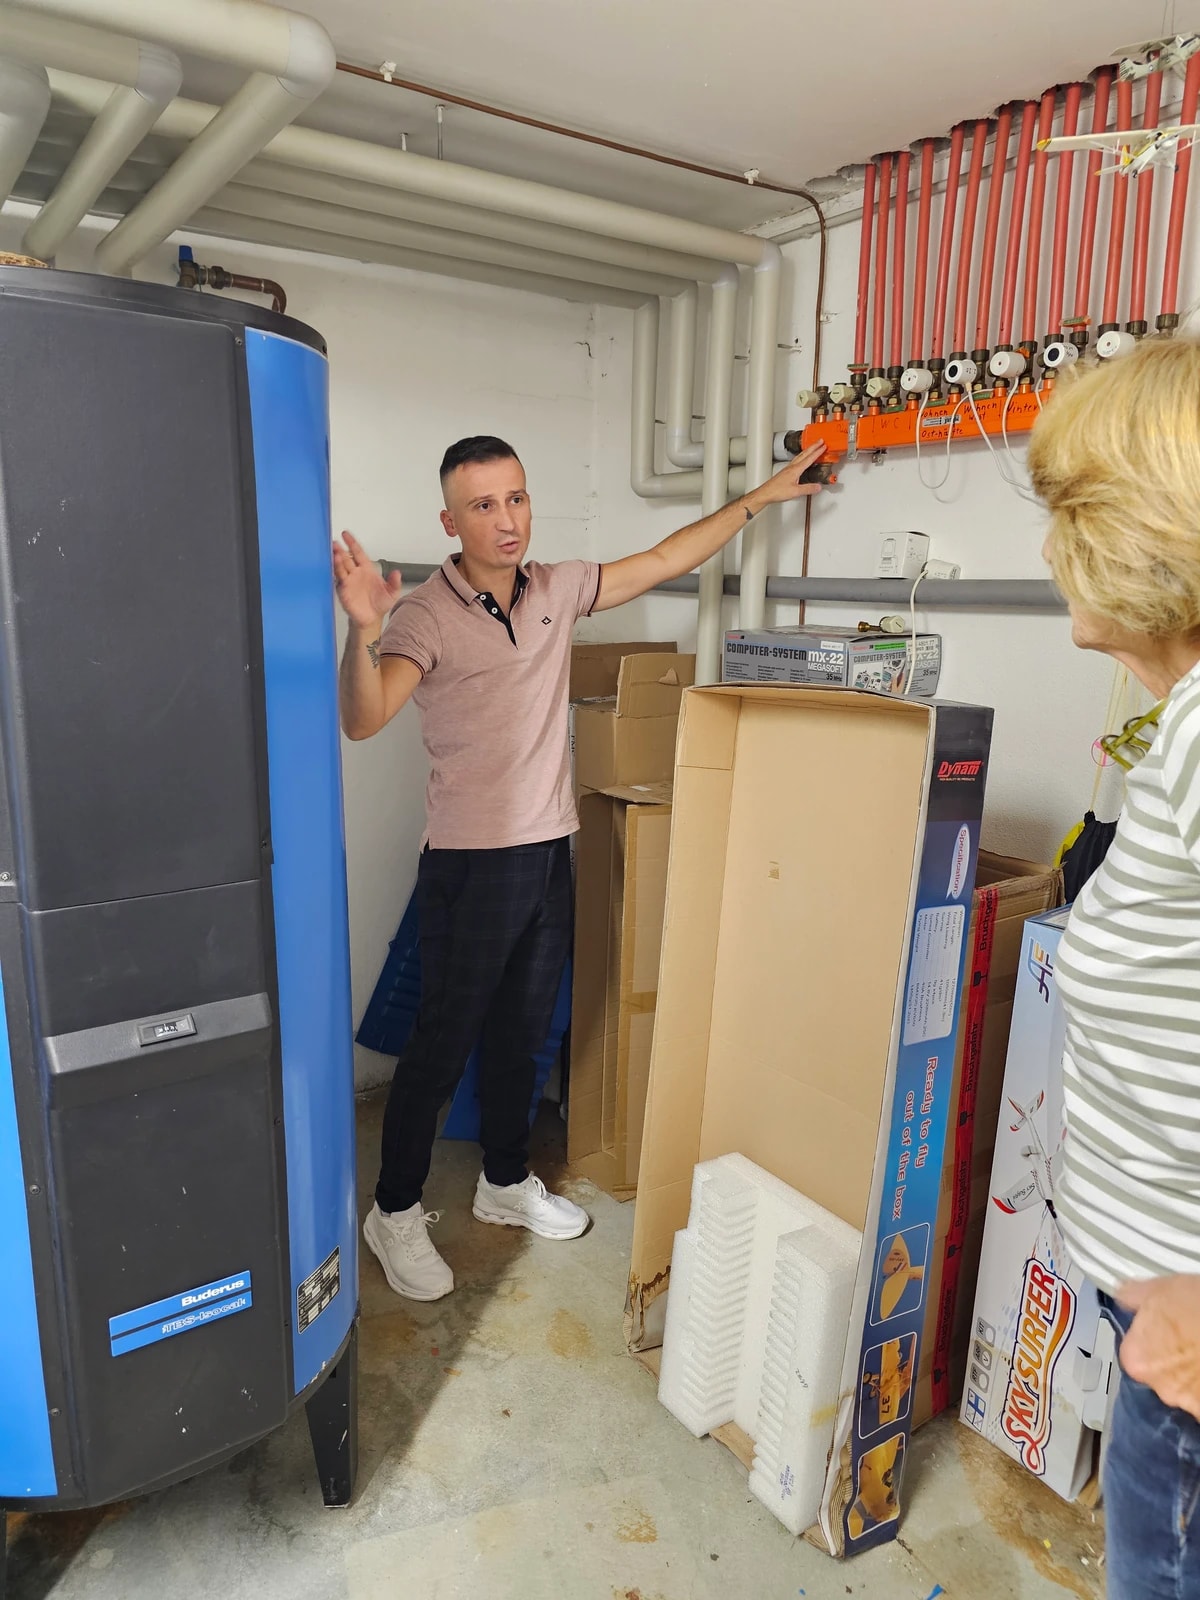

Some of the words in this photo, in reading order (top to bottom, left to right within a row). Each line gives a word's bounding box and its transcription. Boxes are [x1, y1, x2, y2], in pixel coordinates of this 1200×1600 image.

[964, 403, 997, 414] Whnen
[726, 642, 807, 661] COMPUTER-SYSTEM
[807, 662, 843, 673] MEGASOFT
[937, 760, 982, 778] Dynam
[920, 1056, 938, 1115] Ready
[904, 1090, 915, 1123] out
[902, 1127, 912, 1146] of
[920, 1118, 932, 1139] to
[897, 1151, 910, 1182] the
[914, 1144, 929, 1168] fly
[892, 1185, 906, 1221] box
[181, 1280, 245, 1307] Buderus
[1004, 1262, 1056, 1470] SKYSURFER
[881, 1395, 891, 1414] 37
